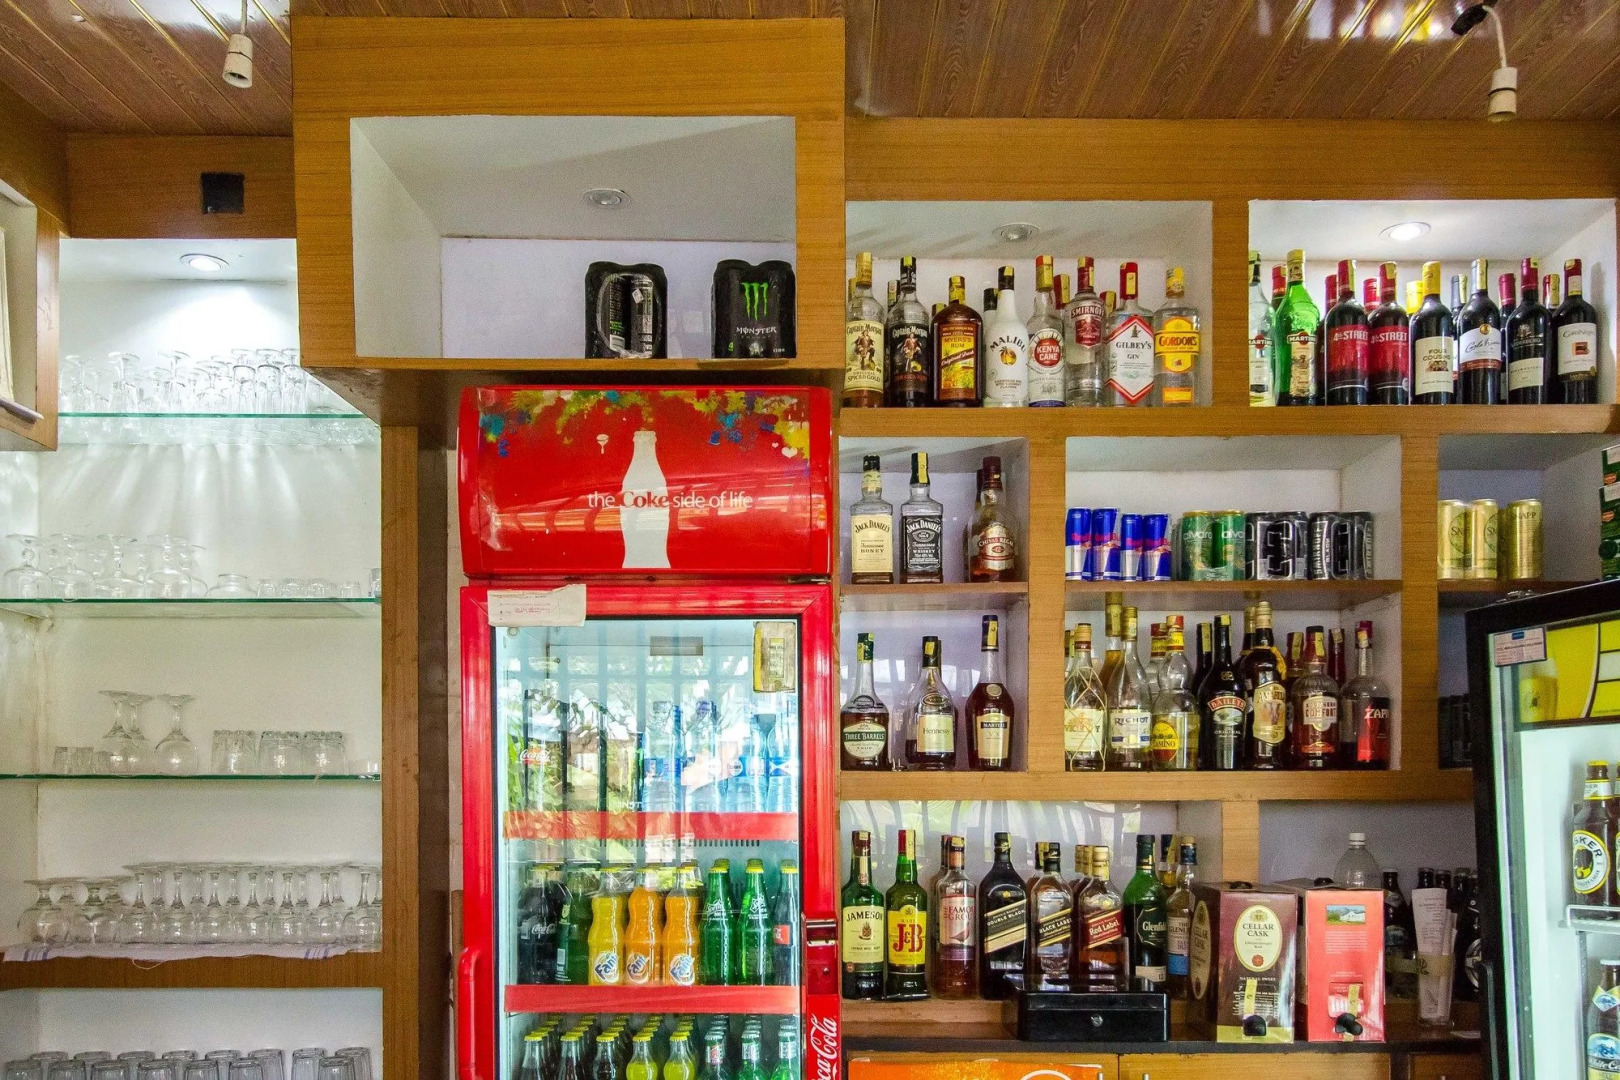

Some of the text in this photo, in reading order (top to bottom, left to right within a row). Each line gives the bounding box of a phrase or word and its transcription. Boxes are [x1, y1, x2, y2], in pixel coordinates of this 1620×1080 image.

[736, 326, 777, 335] MONSTER
[1380, 332, 1408, 342] STREET
[990, 336, 1026, 352] MALIBU
[1036, 345, 1059, 353] KENYA
[1115, 341, 1152, 350] GILBEY'S
[1040, 353, 1058, 361] CANE
[588, 490, 753, 509] the Coke side of life
[855, 523, 869, 533] JACK
[906, 523, 920, 534] JACK
[979, 537, 998, 547] CHIVAS
[1211, 696, 1245, 708] BAILEYS
[1306, 708, 1336, 718] COMFORT
[1114, 716, 1148, 725] RICHOT
[923, 726, 951, 735] Hennessy
[1154, 740, 1176, 748] AMINO
[987, 914, 1007, 926] DOUBLE
[1008, 909, 1026, 919] BLACK
[1039, 924, 1056, 934] BLACK
[1089, 925, 1103, 936] Red
[1103, 919, 1120, 931] Label
[810, 1013, 837, 1080] ca-Cola
